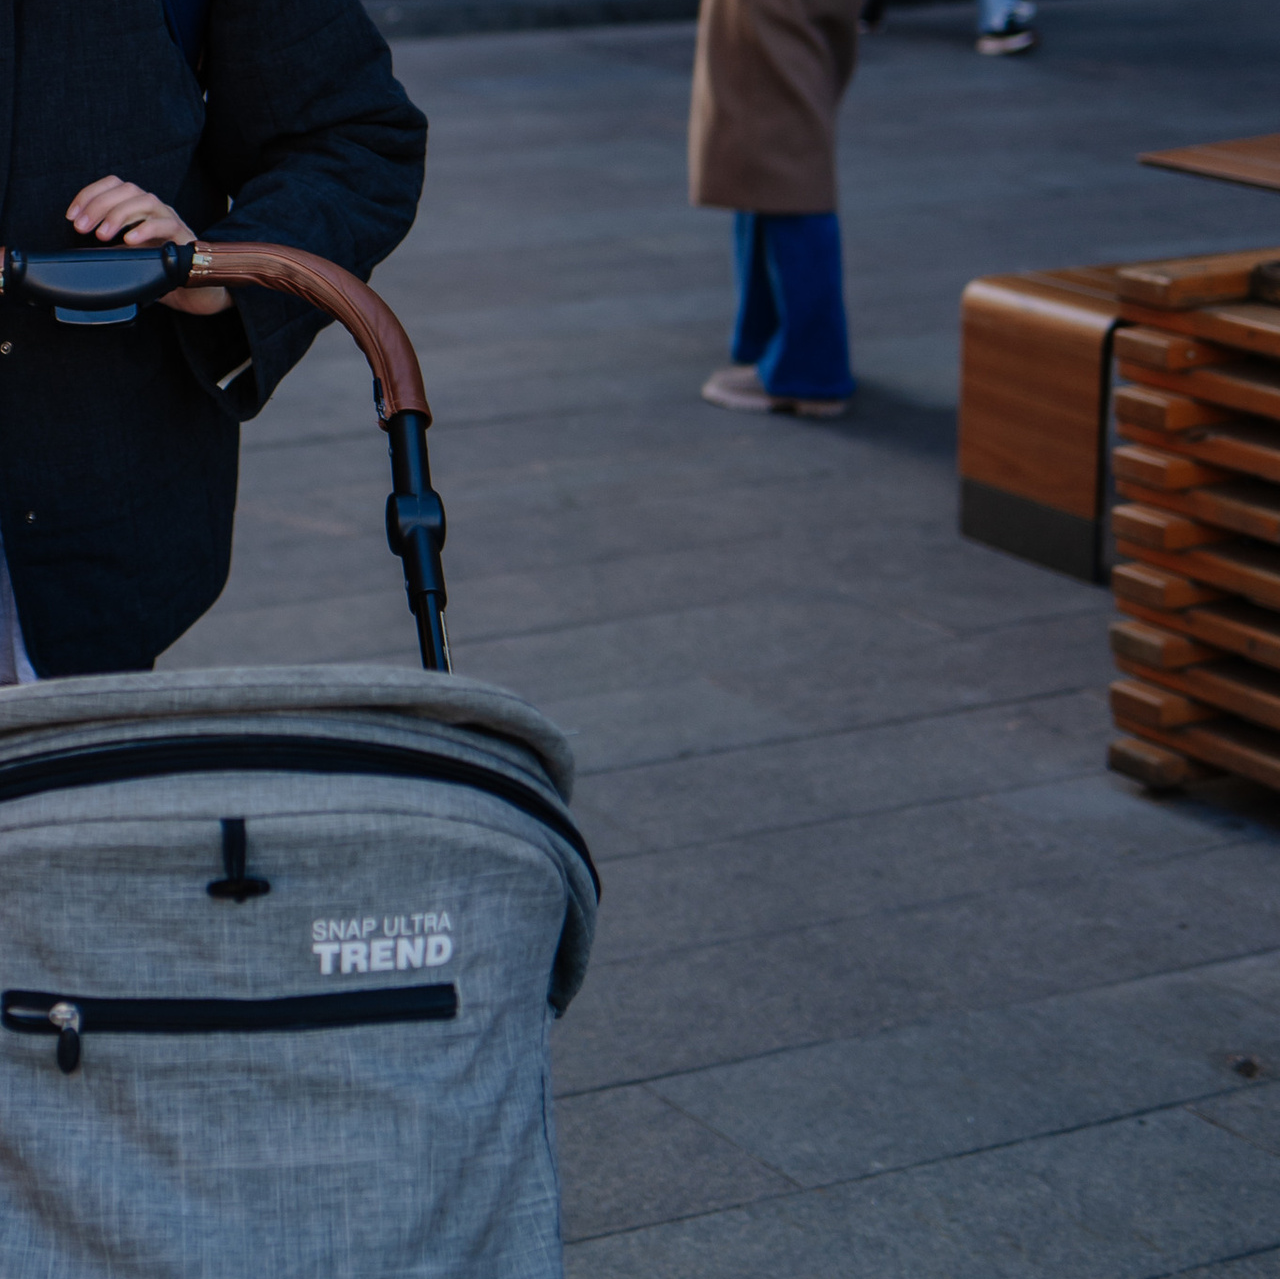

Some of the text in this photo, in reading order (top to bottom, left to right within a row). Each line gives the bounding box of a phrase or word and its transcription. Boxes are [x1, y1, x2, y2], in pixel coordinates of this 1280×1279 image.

[312, 910, 452, 941] SNAP ULTRA
[312, 933, 453, 975] TREND
